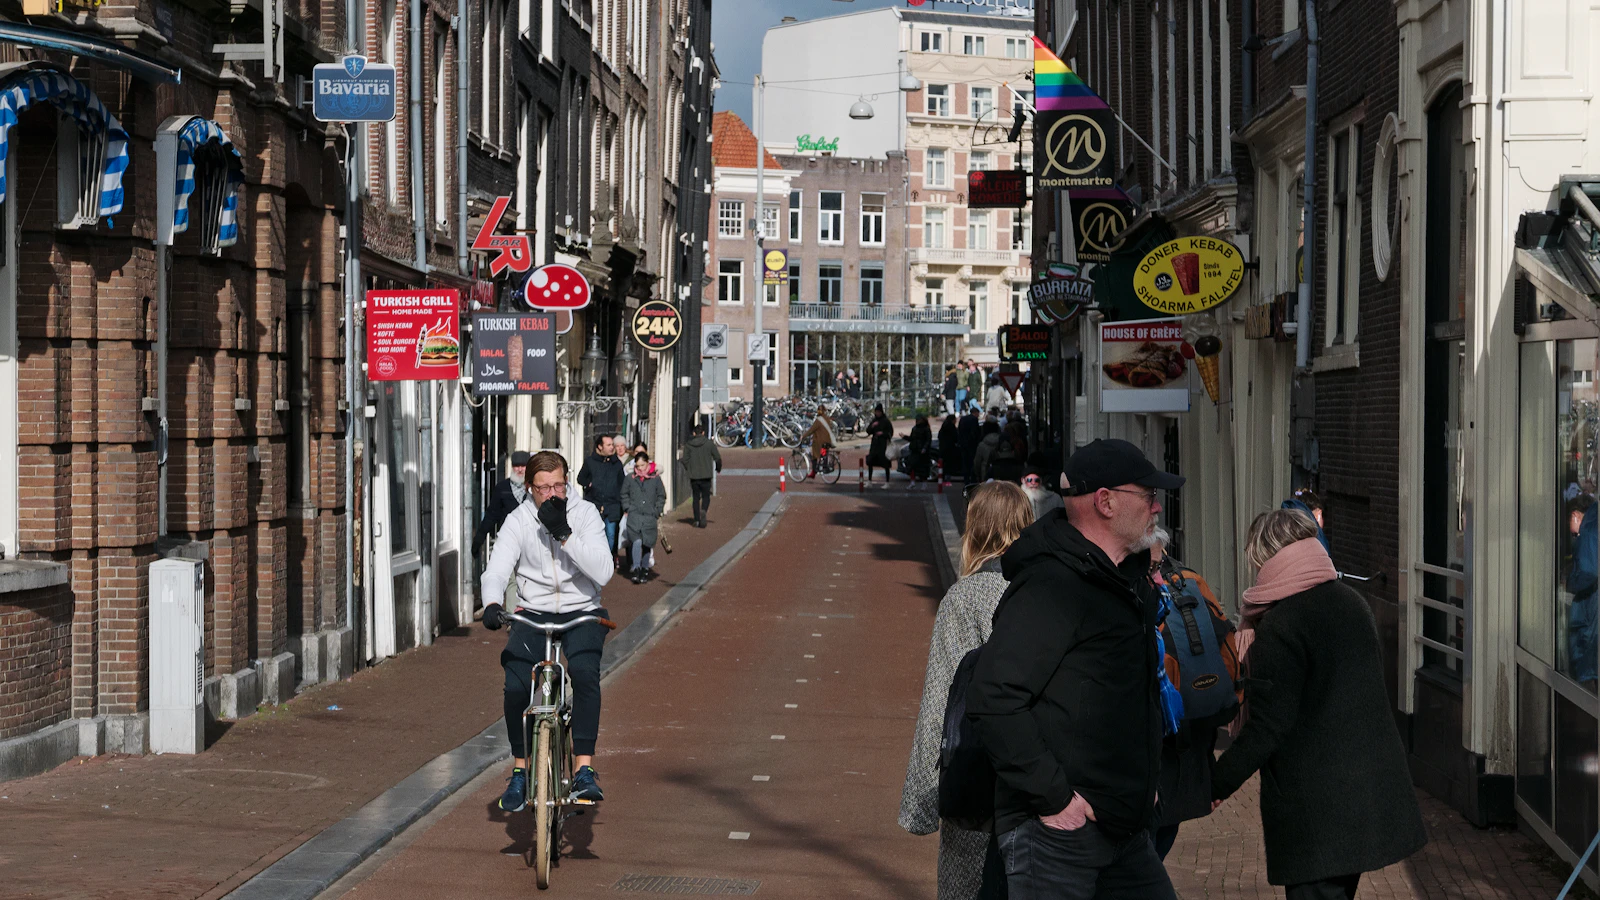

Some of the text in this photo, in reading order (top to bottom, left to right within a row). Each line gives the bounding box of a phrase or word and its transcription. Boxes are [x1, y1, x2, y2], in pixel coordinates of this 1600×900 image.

[319, 79, 390, 96] Bavaria
[980, 180, 1022, 192] KLEINE
[1039, 176, 1112, 186] montmartre
[970, 192, 1022, 204] KOMEDIE
[1140, 239, 1234, 274] DONER KEBAB
[1032, 280, 1092, 298] BURRATA
[1138, 286, 1196, 312] SHOARMA
[1200, 265, 1242, 306] FALAFEL
[372, 296, 420, 307] TURKISH
[422, 296, 453, 306] GRILL
[478, 317, 549, 331] TURKISH KEBAB
[636, 316, 678, 336] 24K
[848, 322, 864, 330] de
[1103, 326, 1182, 339] HOUSE OF CRÊPE
[648, 334, 666, 344] bar
[480, 348, 546, 357] HALAL FOOD
[480, 363, 504, 377] حلال
[479, 382, 550, 391] SHOARMA FALAFEL
